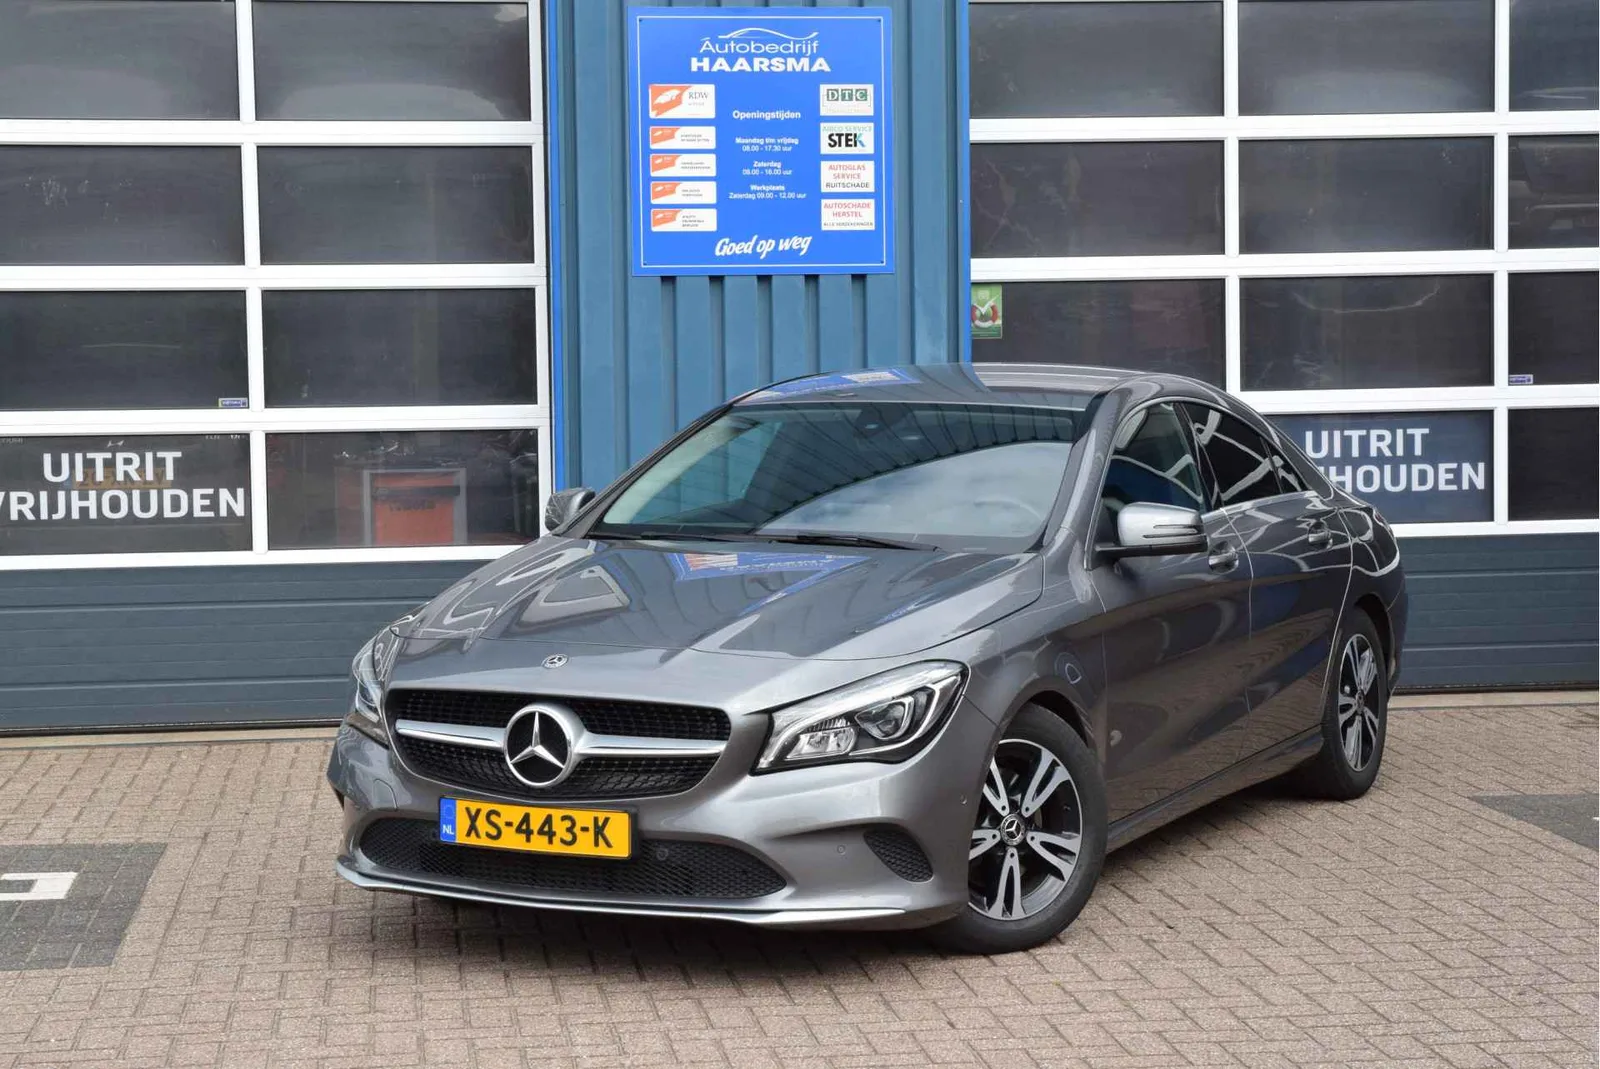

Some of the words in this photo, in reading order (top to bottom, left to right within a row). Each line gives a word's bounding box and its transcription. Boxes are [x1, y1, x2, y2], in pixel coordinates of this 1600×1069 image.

[700, 39, 820, 57] Autobedrijf
[690, 56, 832, 73] HAARSMA
[688, 91, 709, 100] RDW
[827, 89, 868, 101] DTC
[732, 109, 802, 121] Openingstijden
[735, 136, 765, 145] Maandag
[777, 136, 800, 145] vrijdag
[827, 132, 866, 149] STEK
[753, 160, 782, 169] Zaterdag
[750, 184, 786, 192] Werkplaats
[729, 192, 757, 201] Zaterdag
[715, 234, 759, 257] Goed
[756, 239, 776, 260] op
[778, 235, 813, 257] weg
[1305, 428, 1430, 459] UITRIT
[42, 451, 182, 483] UITRIT
[442, 824, 455, 836] NL
[464, 806, 613, 849] XS-443-K
